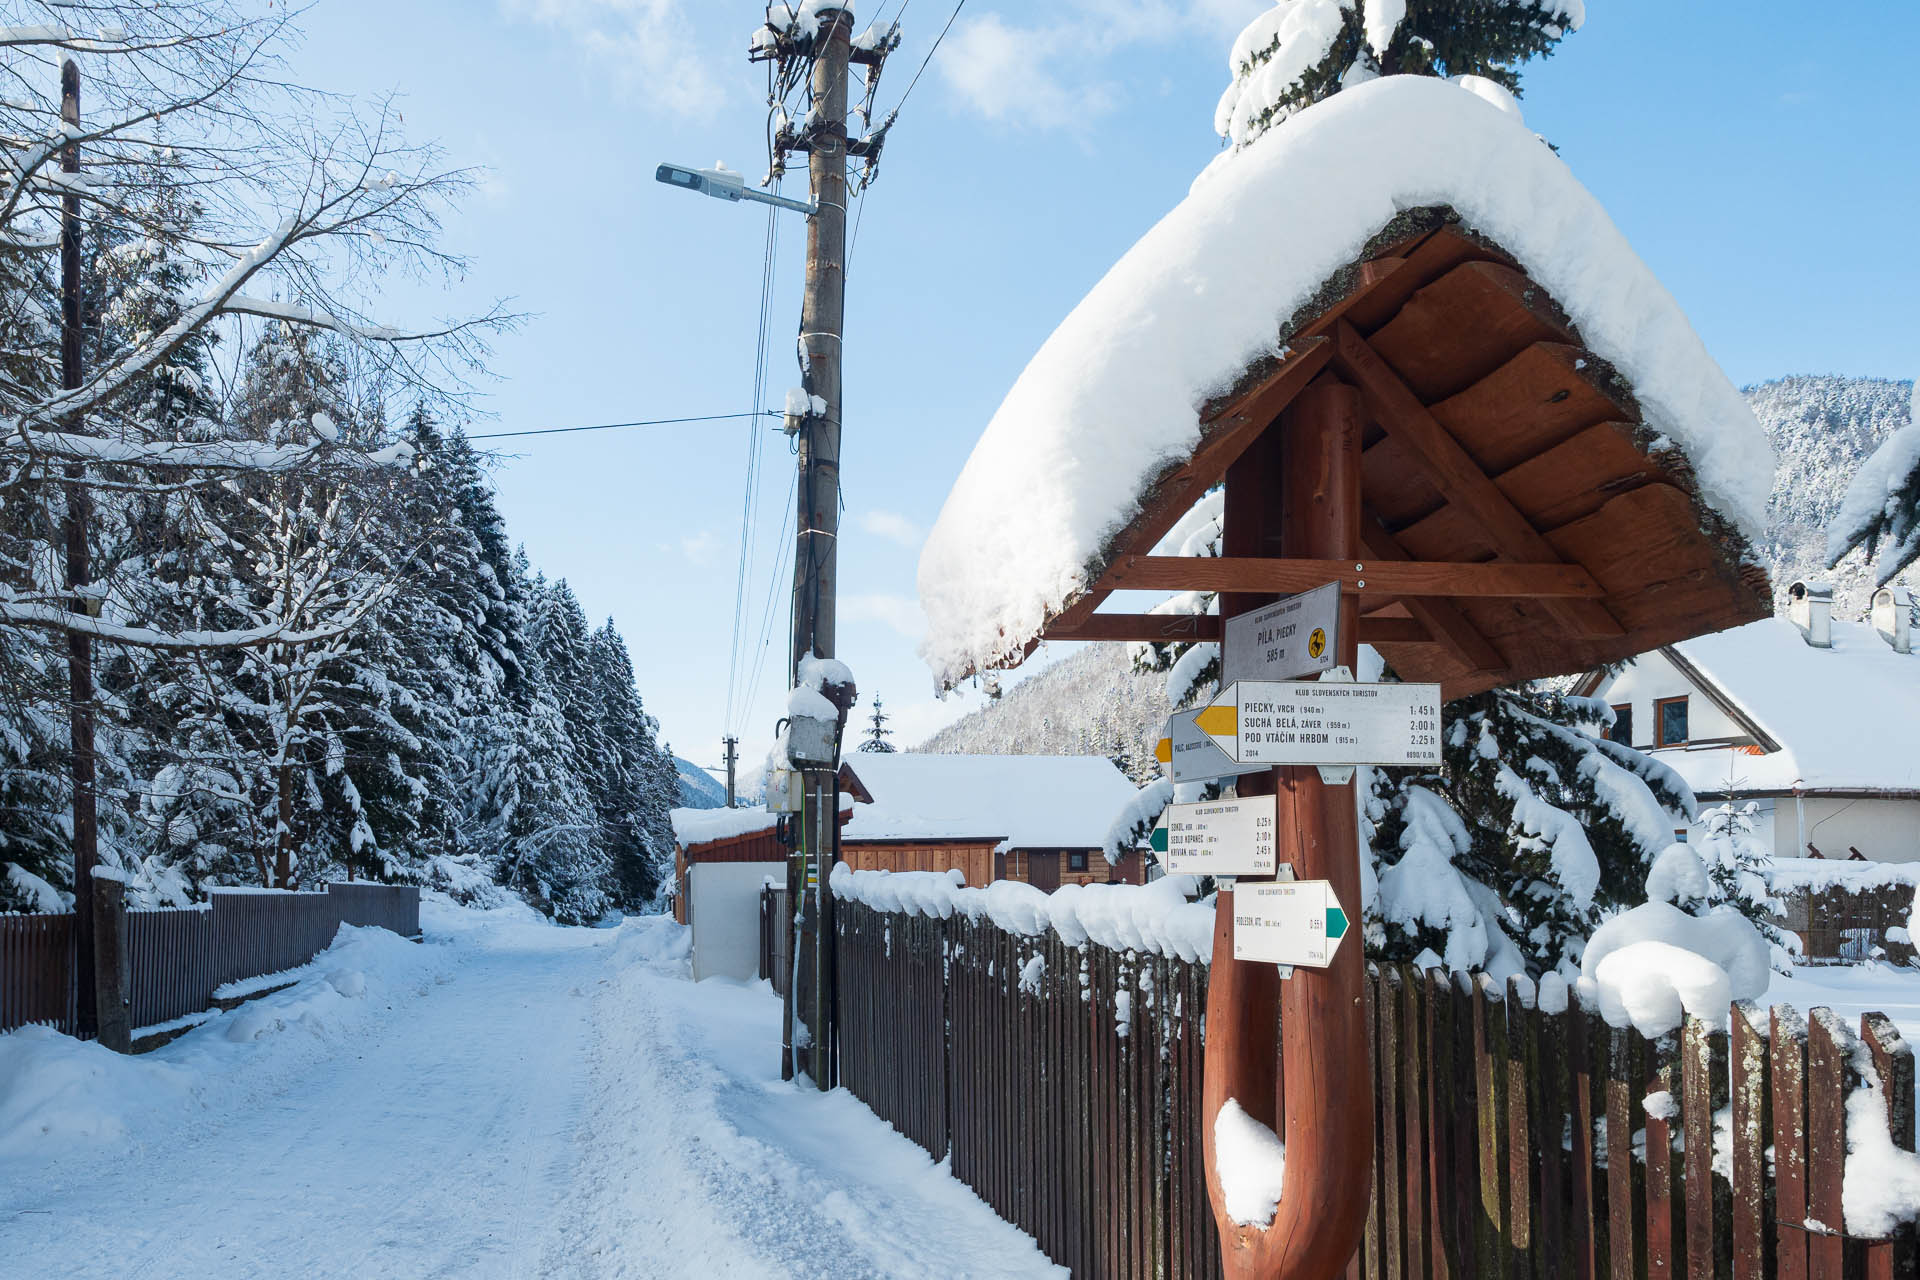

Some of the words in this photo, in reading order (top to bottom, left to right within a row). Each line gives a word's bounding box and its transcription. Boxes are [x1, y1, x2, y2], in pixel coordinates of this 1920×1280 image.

[1257, 627, 1275, 647] PÍLA,
[1276, 623, 1297, 641] PIECKY
[1266, 648, 1278, 663] 585
[1295, 689, 1310, 697] KLUB
[1311, 688, 1350, 697] SLOVENSKÝCH
[1352, 689, 1378, 698] TURISTOV
[1244, 702, 1275, 714] PIECKY,
[1277, 704, 1295, 713] VRCH
[1409, 705, 1428, 716] 1:45
[1429, 705, 1435, 716] h
[1244, 715, 1272, 728] SUCHÁ
[1276, 715, 1299, 729] BELÁ,
[1301, 719, 1322, 729] ZÁVER
[1410, 720, 1428, 731] 2:00
[1430, 720, 1435, 731] h
[1245, 732, 1261, 743] POD
[1265, 731, 1295, 743] VTÁČÍM
[1299, 733, 1329, 744] HRBOM
[1410, 735, 1428, 745] 2:25
[1430, 735, 1435, 745] h
[1245, 749, 1259, 757] 2014
